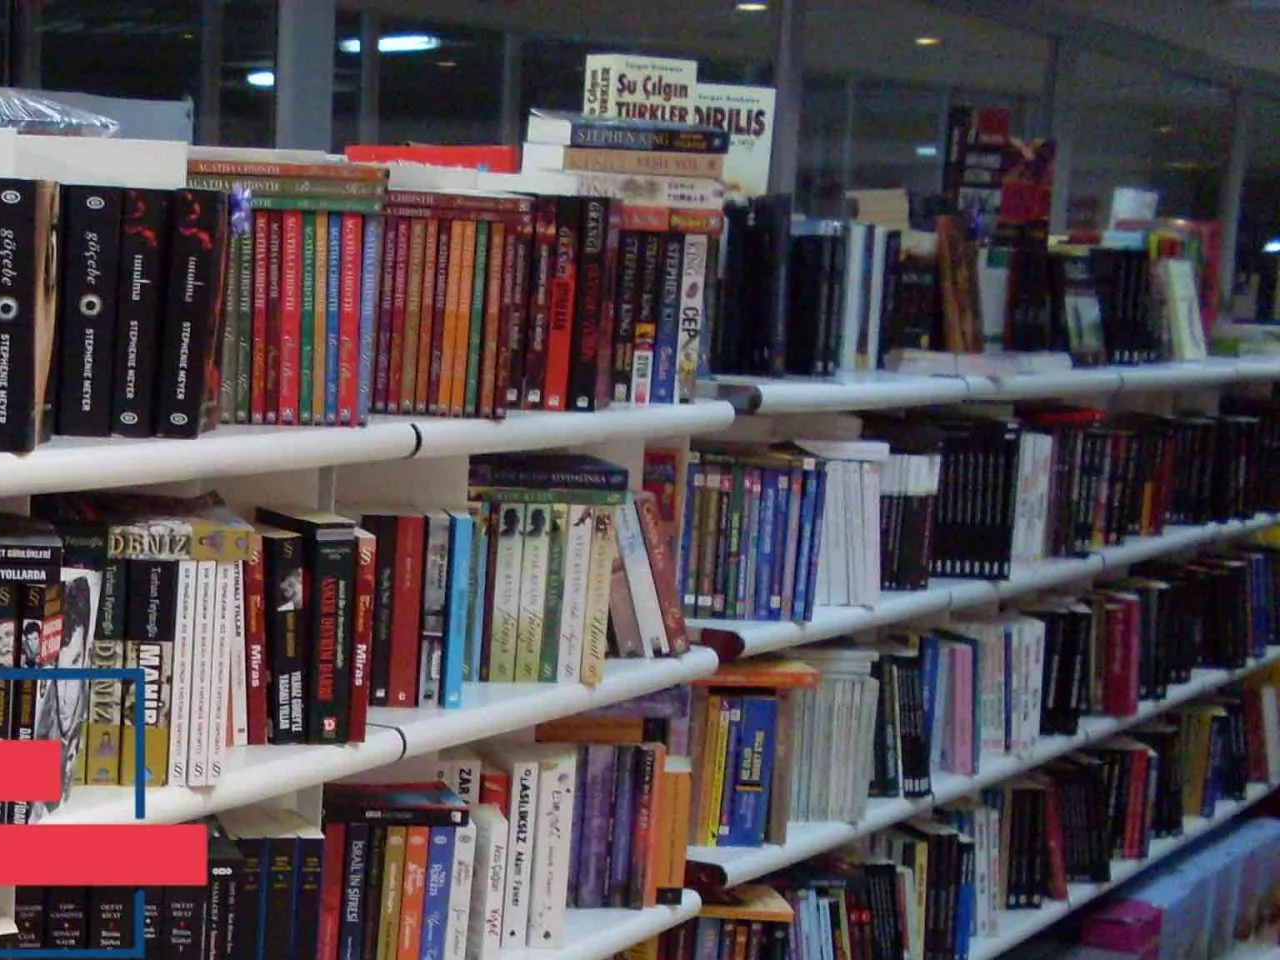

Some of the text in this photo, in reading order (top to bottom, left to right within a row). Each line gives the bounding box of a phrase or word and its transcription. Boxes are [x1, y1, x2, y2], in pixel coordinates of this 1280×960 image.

[642, 75, 689, 101] Çılgın
[81, 327, 96, 413] STEPHENIE MEYER
[0, 567, 47, 581] YOLLARDA
[251, 644, 262, 688] Miras
[354, 644, 367, 688] Miras
